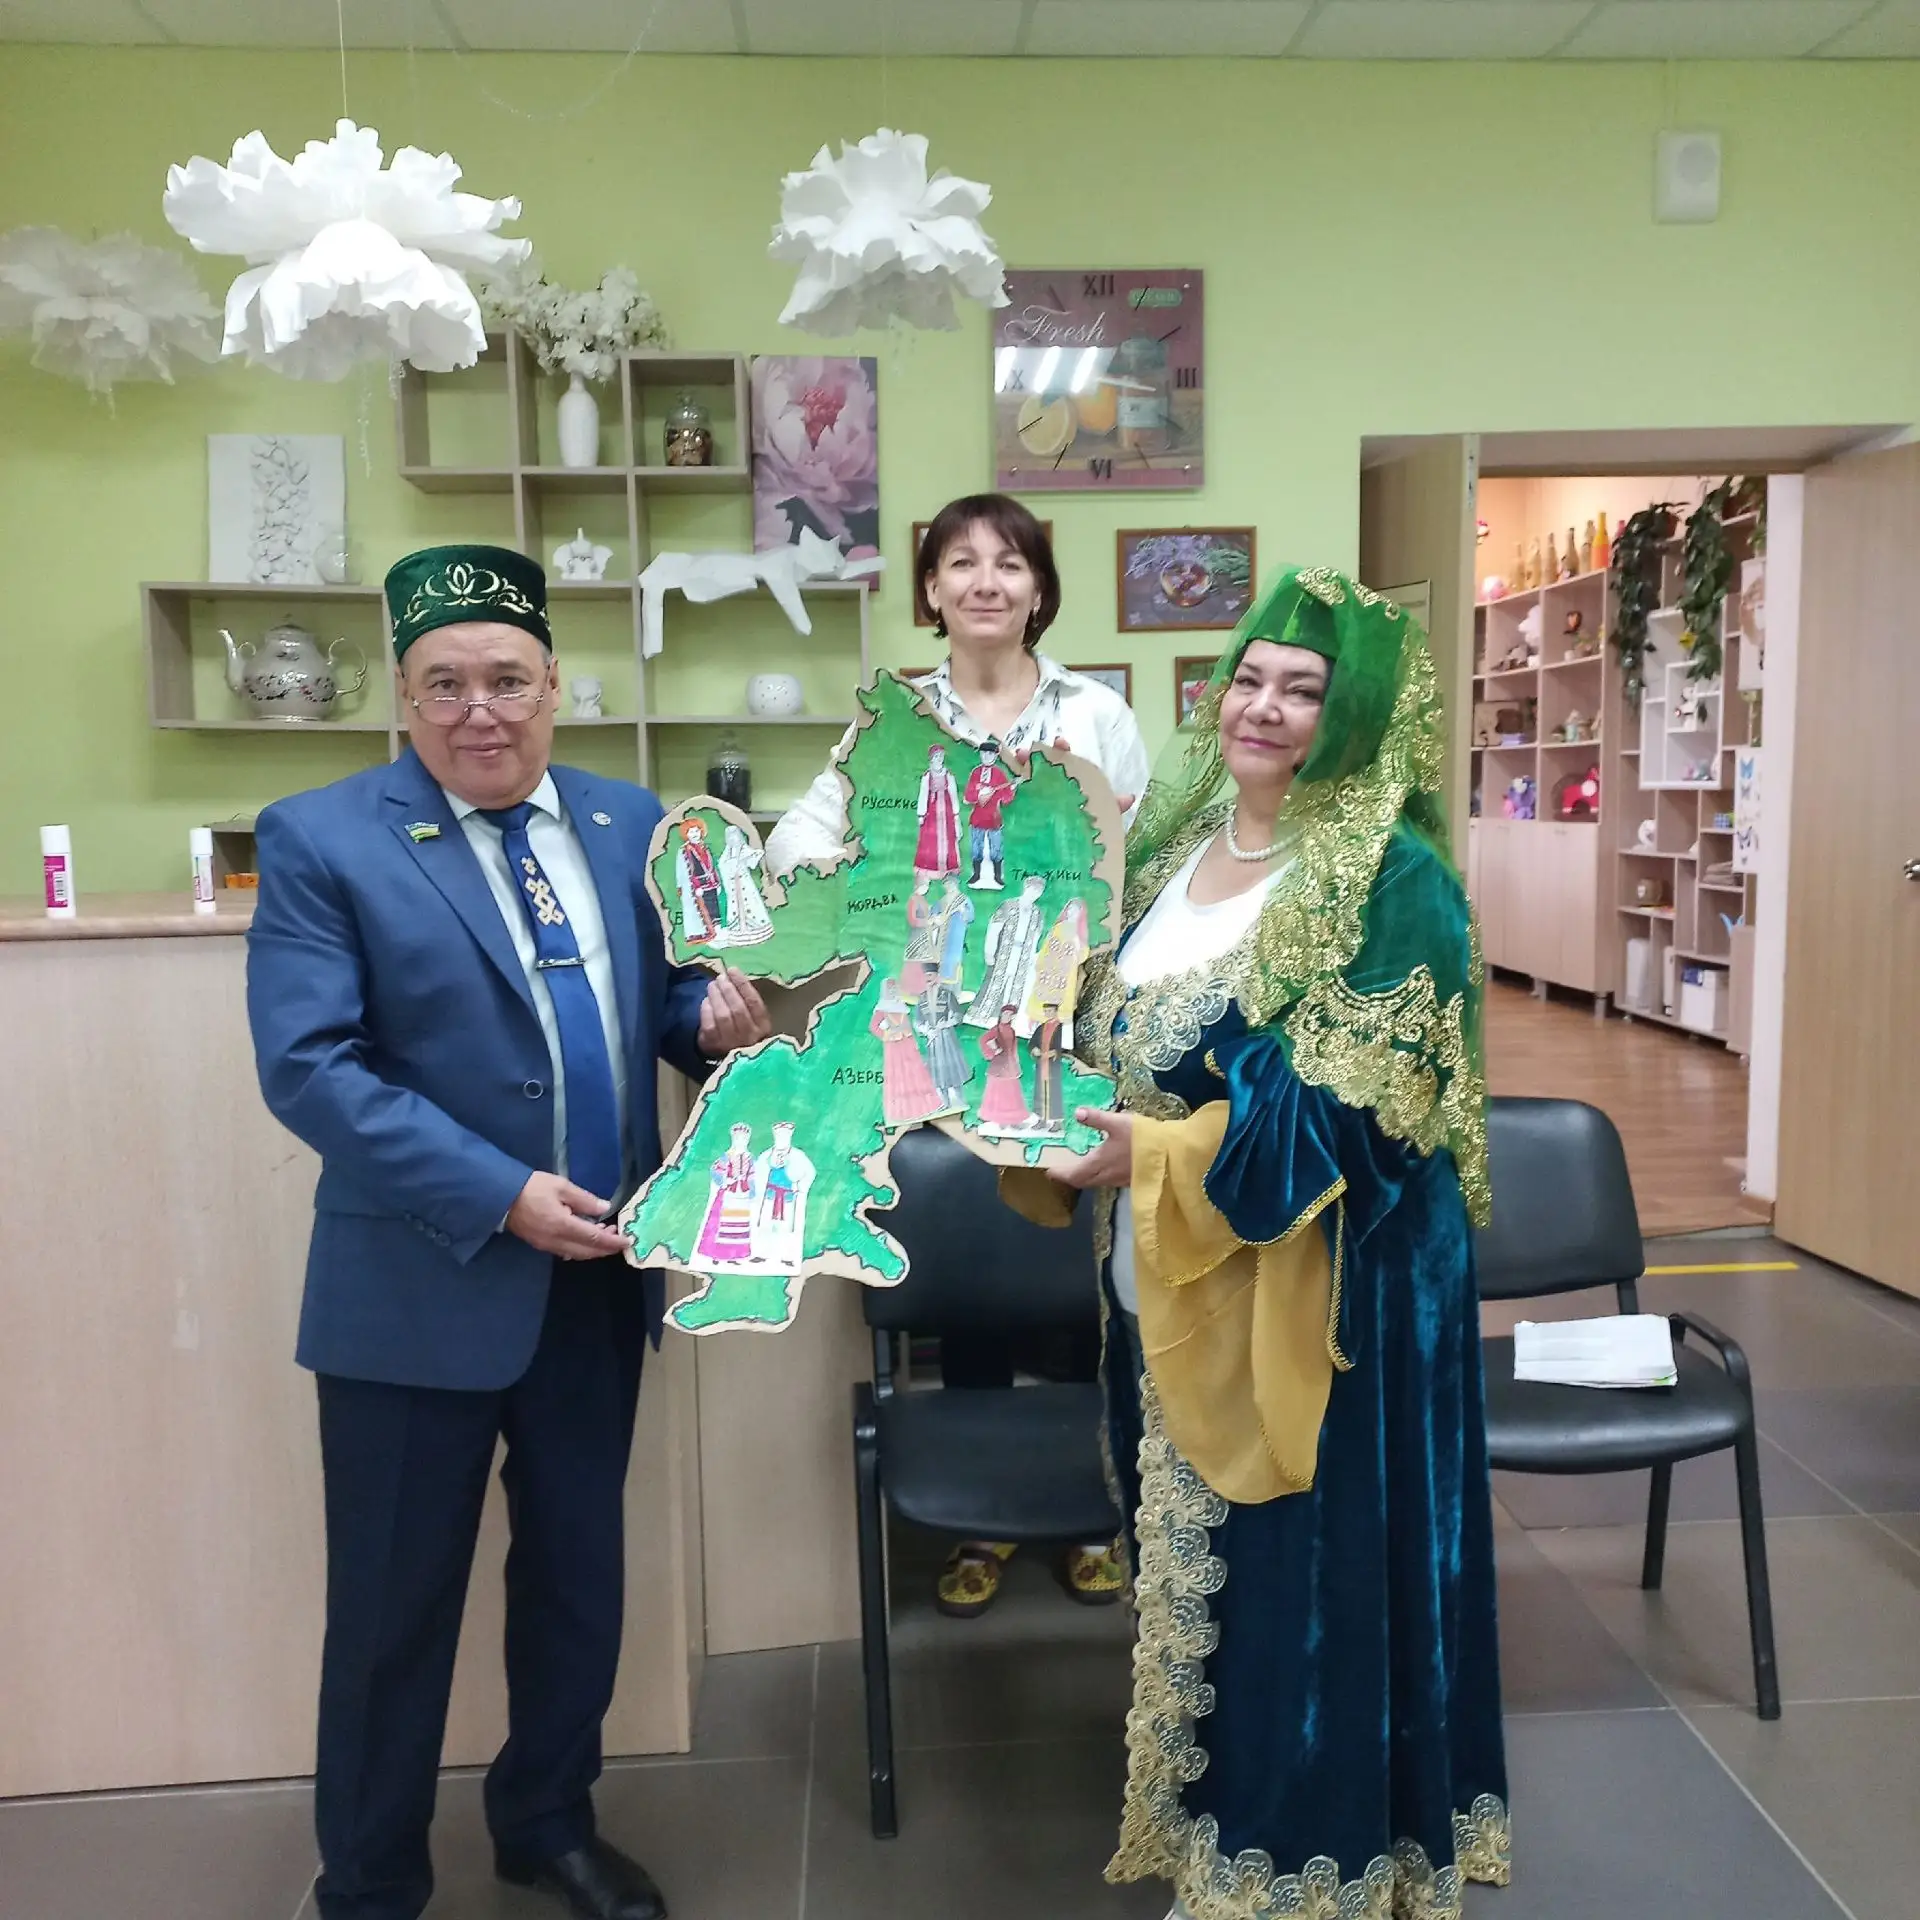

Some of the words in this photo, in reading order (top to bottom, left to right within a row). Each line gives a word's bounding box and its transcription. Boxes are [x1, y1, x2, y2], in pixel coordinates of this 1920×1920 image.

[1083, 274, 1115, 296] XII
[1004, 304, 1106, 343] Fresh
[1176, 367, 1197, 389] III
[1090, 458, 1112, 480] VI
[1011, 867, 1082, 881] ТАЖИКИ
[831, 1066, 885, 1085] АЗЕРБ
